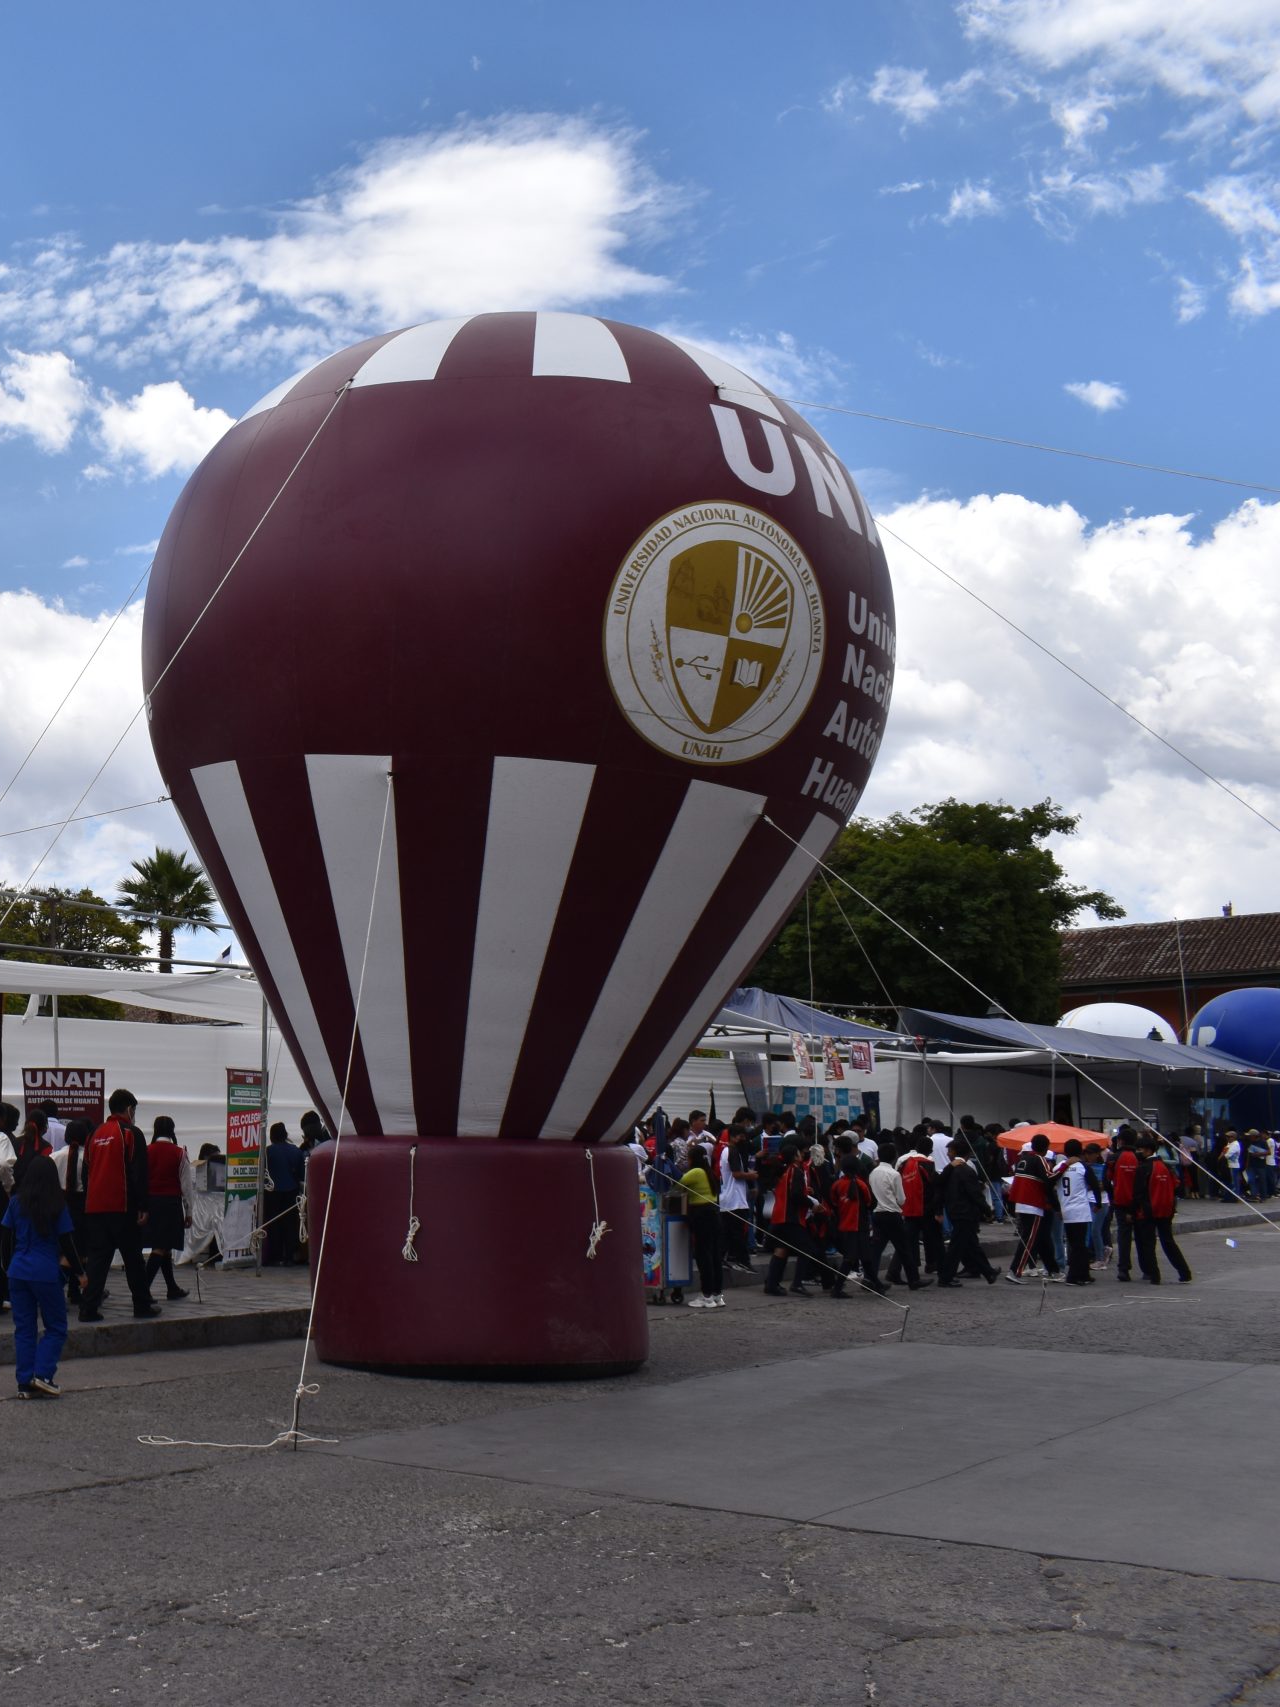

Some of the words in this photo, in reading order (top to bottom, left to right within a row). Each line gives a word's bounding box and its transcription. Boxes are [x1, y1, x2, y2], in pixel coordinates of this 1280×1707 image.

[613, 526, 672, 616] UNIVERSIDAD
[672, 508, 739, 530] NACIONAL
[743, 513, 802, 568] AUTÓNOMA
[801, 568, 814, 589] DE
[809, 593, 822, 654] HUANTA
[682, 741, 723, 759] UNAH
[24, 1071, 102, 1088] UNAH
[229, 1115, 240, 1127] DEL
[1062, 1176, 1071, 1197] 9
